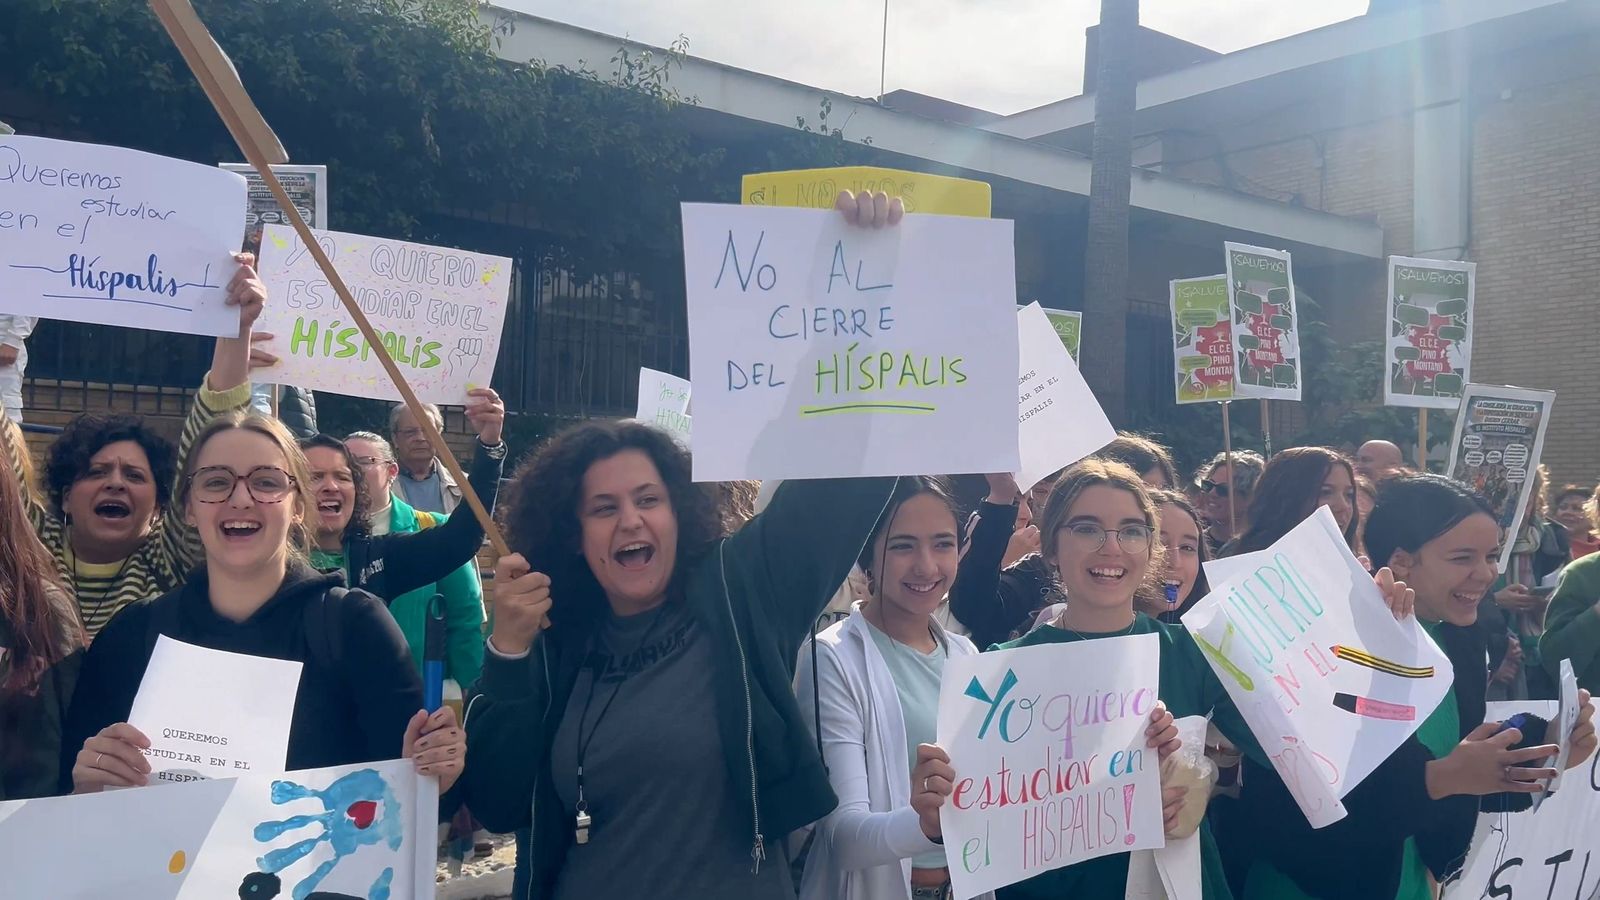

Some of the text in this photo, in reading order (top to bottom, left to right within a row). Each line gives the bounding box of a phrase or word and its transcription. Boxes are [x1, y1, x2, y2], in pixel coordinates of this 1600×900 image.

[0, 145, 122, 190] Queremos
[80, 194, 176, 221] estudiar
[0, 210, 92, 245] en el
[827, 239, 893, 293] AL
[769, 304, 895, 340] CIERRE
[1209, 345, 1218, 354] EL
[727, 342, 967, 394] DEL HÍSPALIS
[1033, 384, 1045, 394] EN
[1046, 377, 1058, 386] EL
[964, 667, 1153, 760] Yo quiero
[162, 727, 229, 746] QUEREMOS
[142, 748, 251, 770] STUDIAR EN EL
[952, 746, 1144, 810] estudiar en
[962, 819, 992, 874] el
